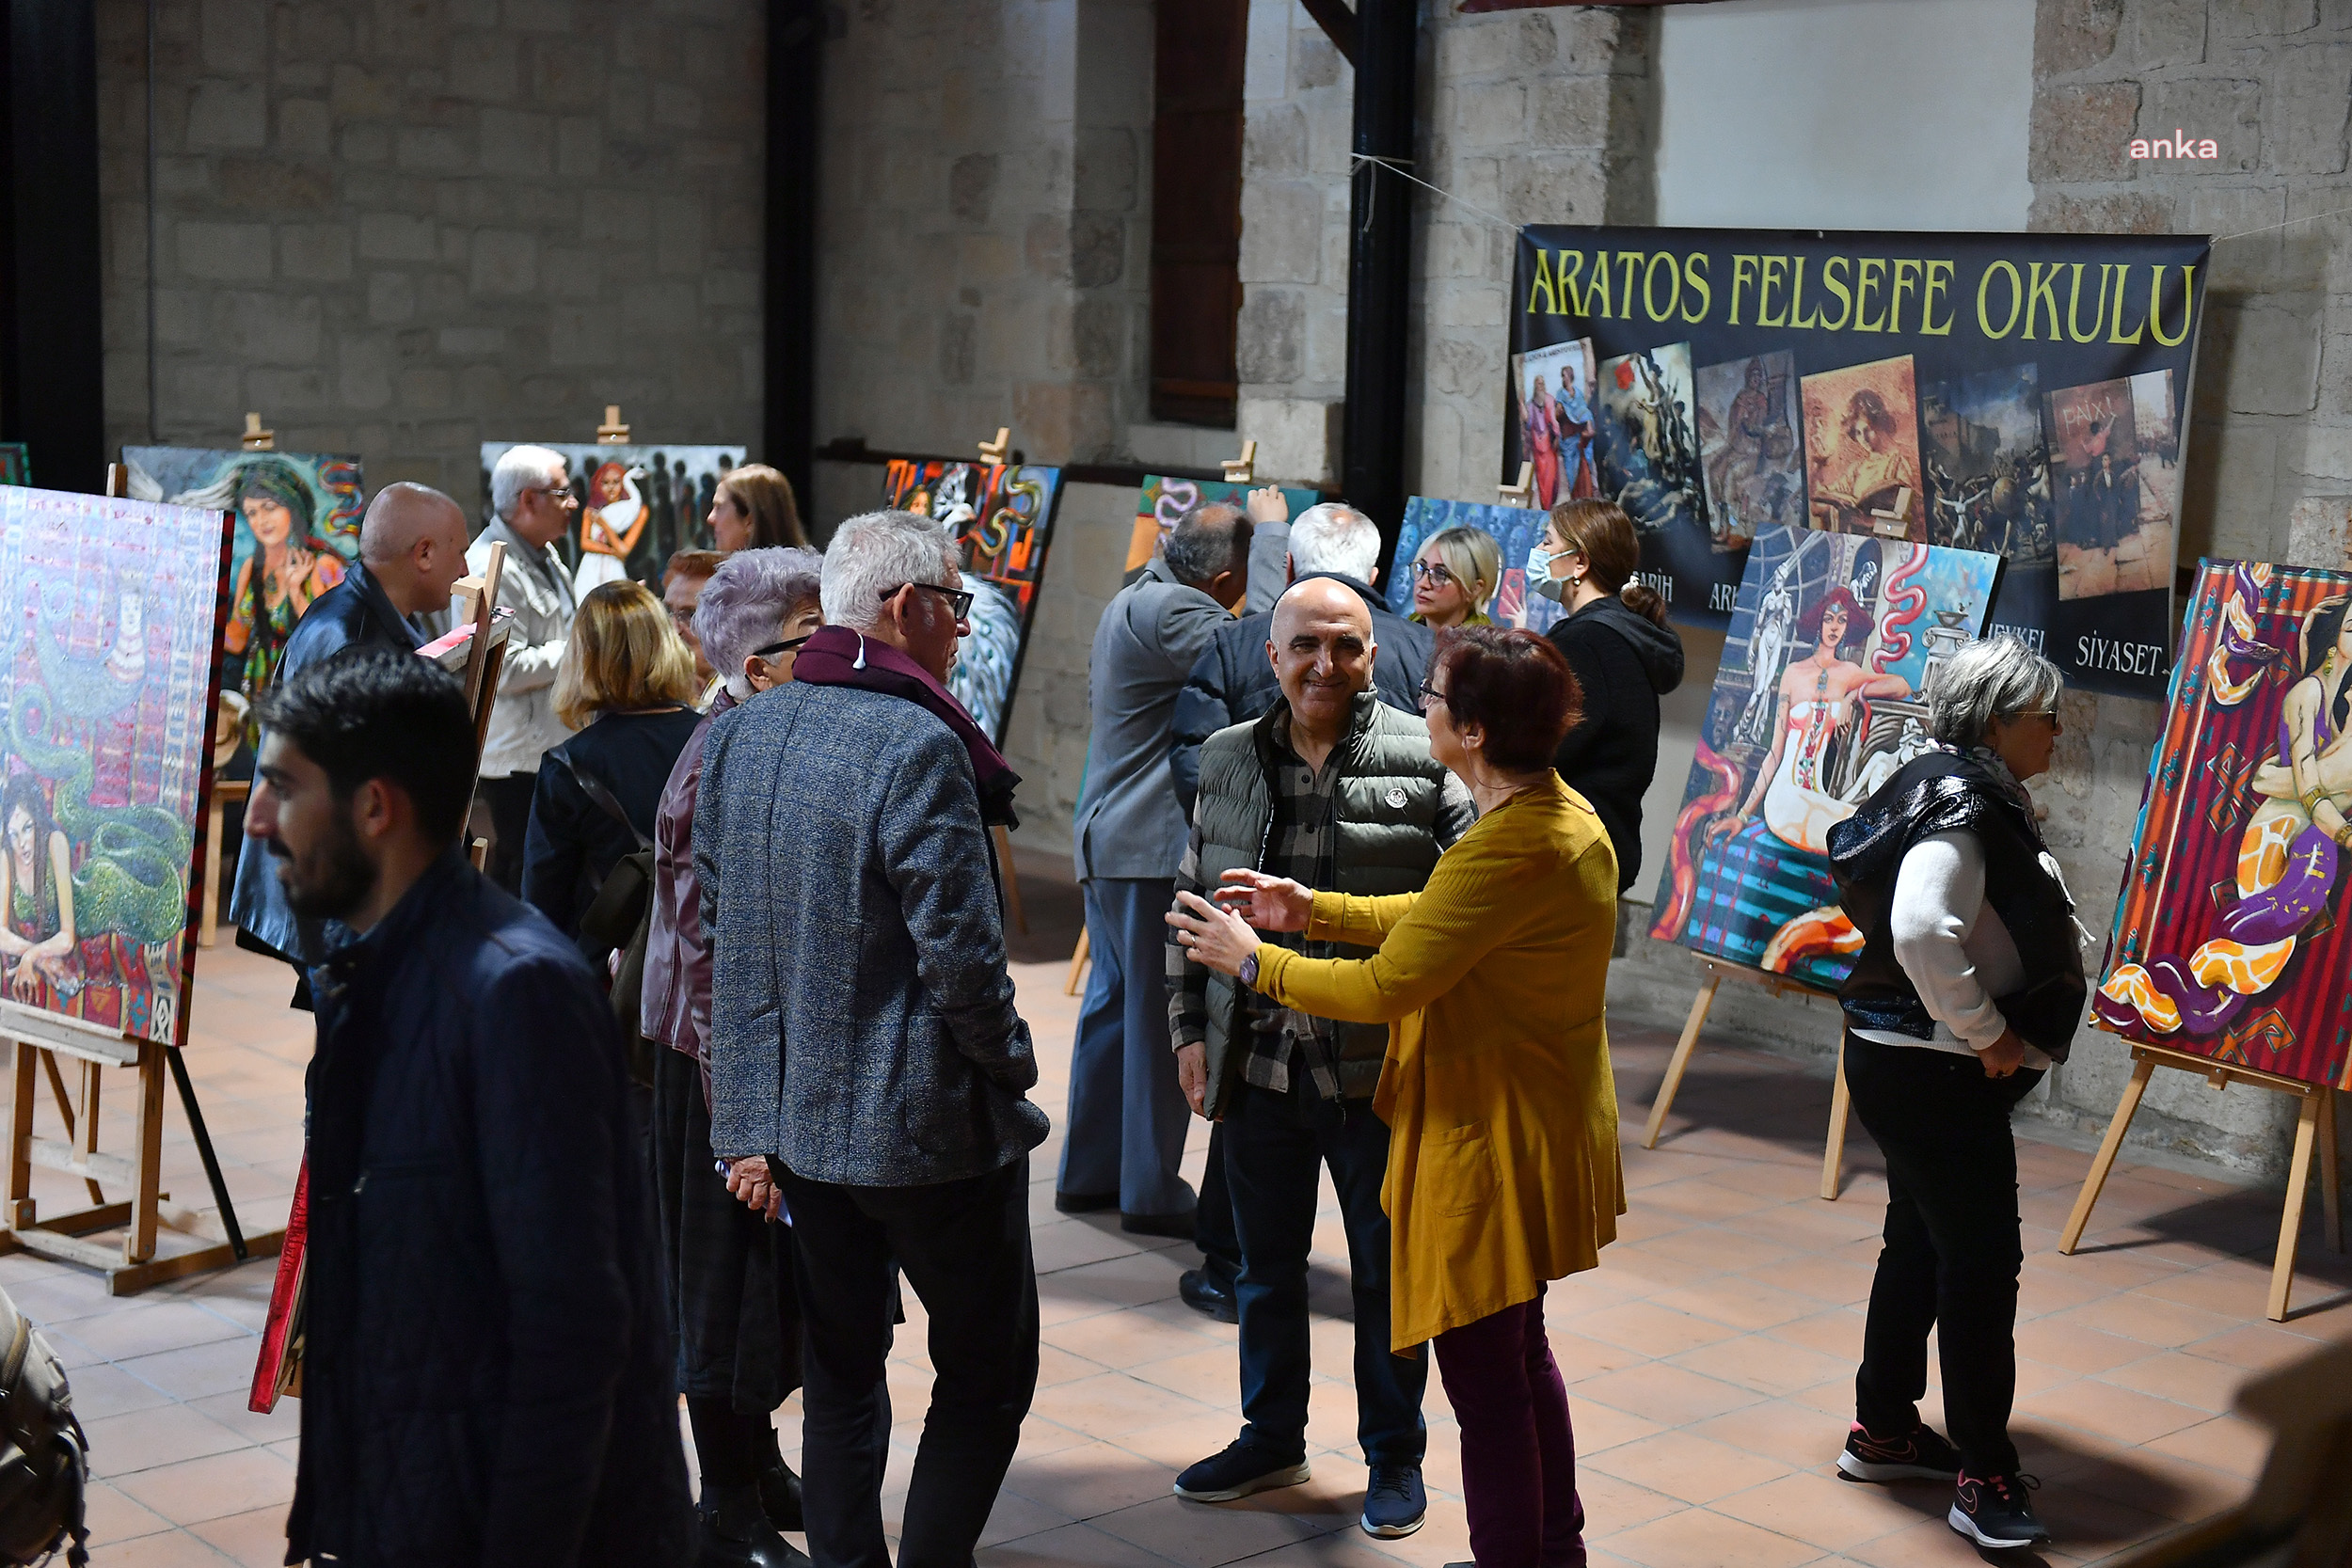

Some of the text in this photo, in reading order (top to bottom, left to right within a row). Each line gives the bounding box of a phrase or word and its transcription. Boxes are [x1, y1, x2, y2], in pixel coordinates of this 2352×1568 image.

[1527, 248, 2197, 347] ARATOS FELSEFE OKULU
[1632, 567, 1673, 602] ARİH
[2075, 629, 2163, 677] SİYASET
